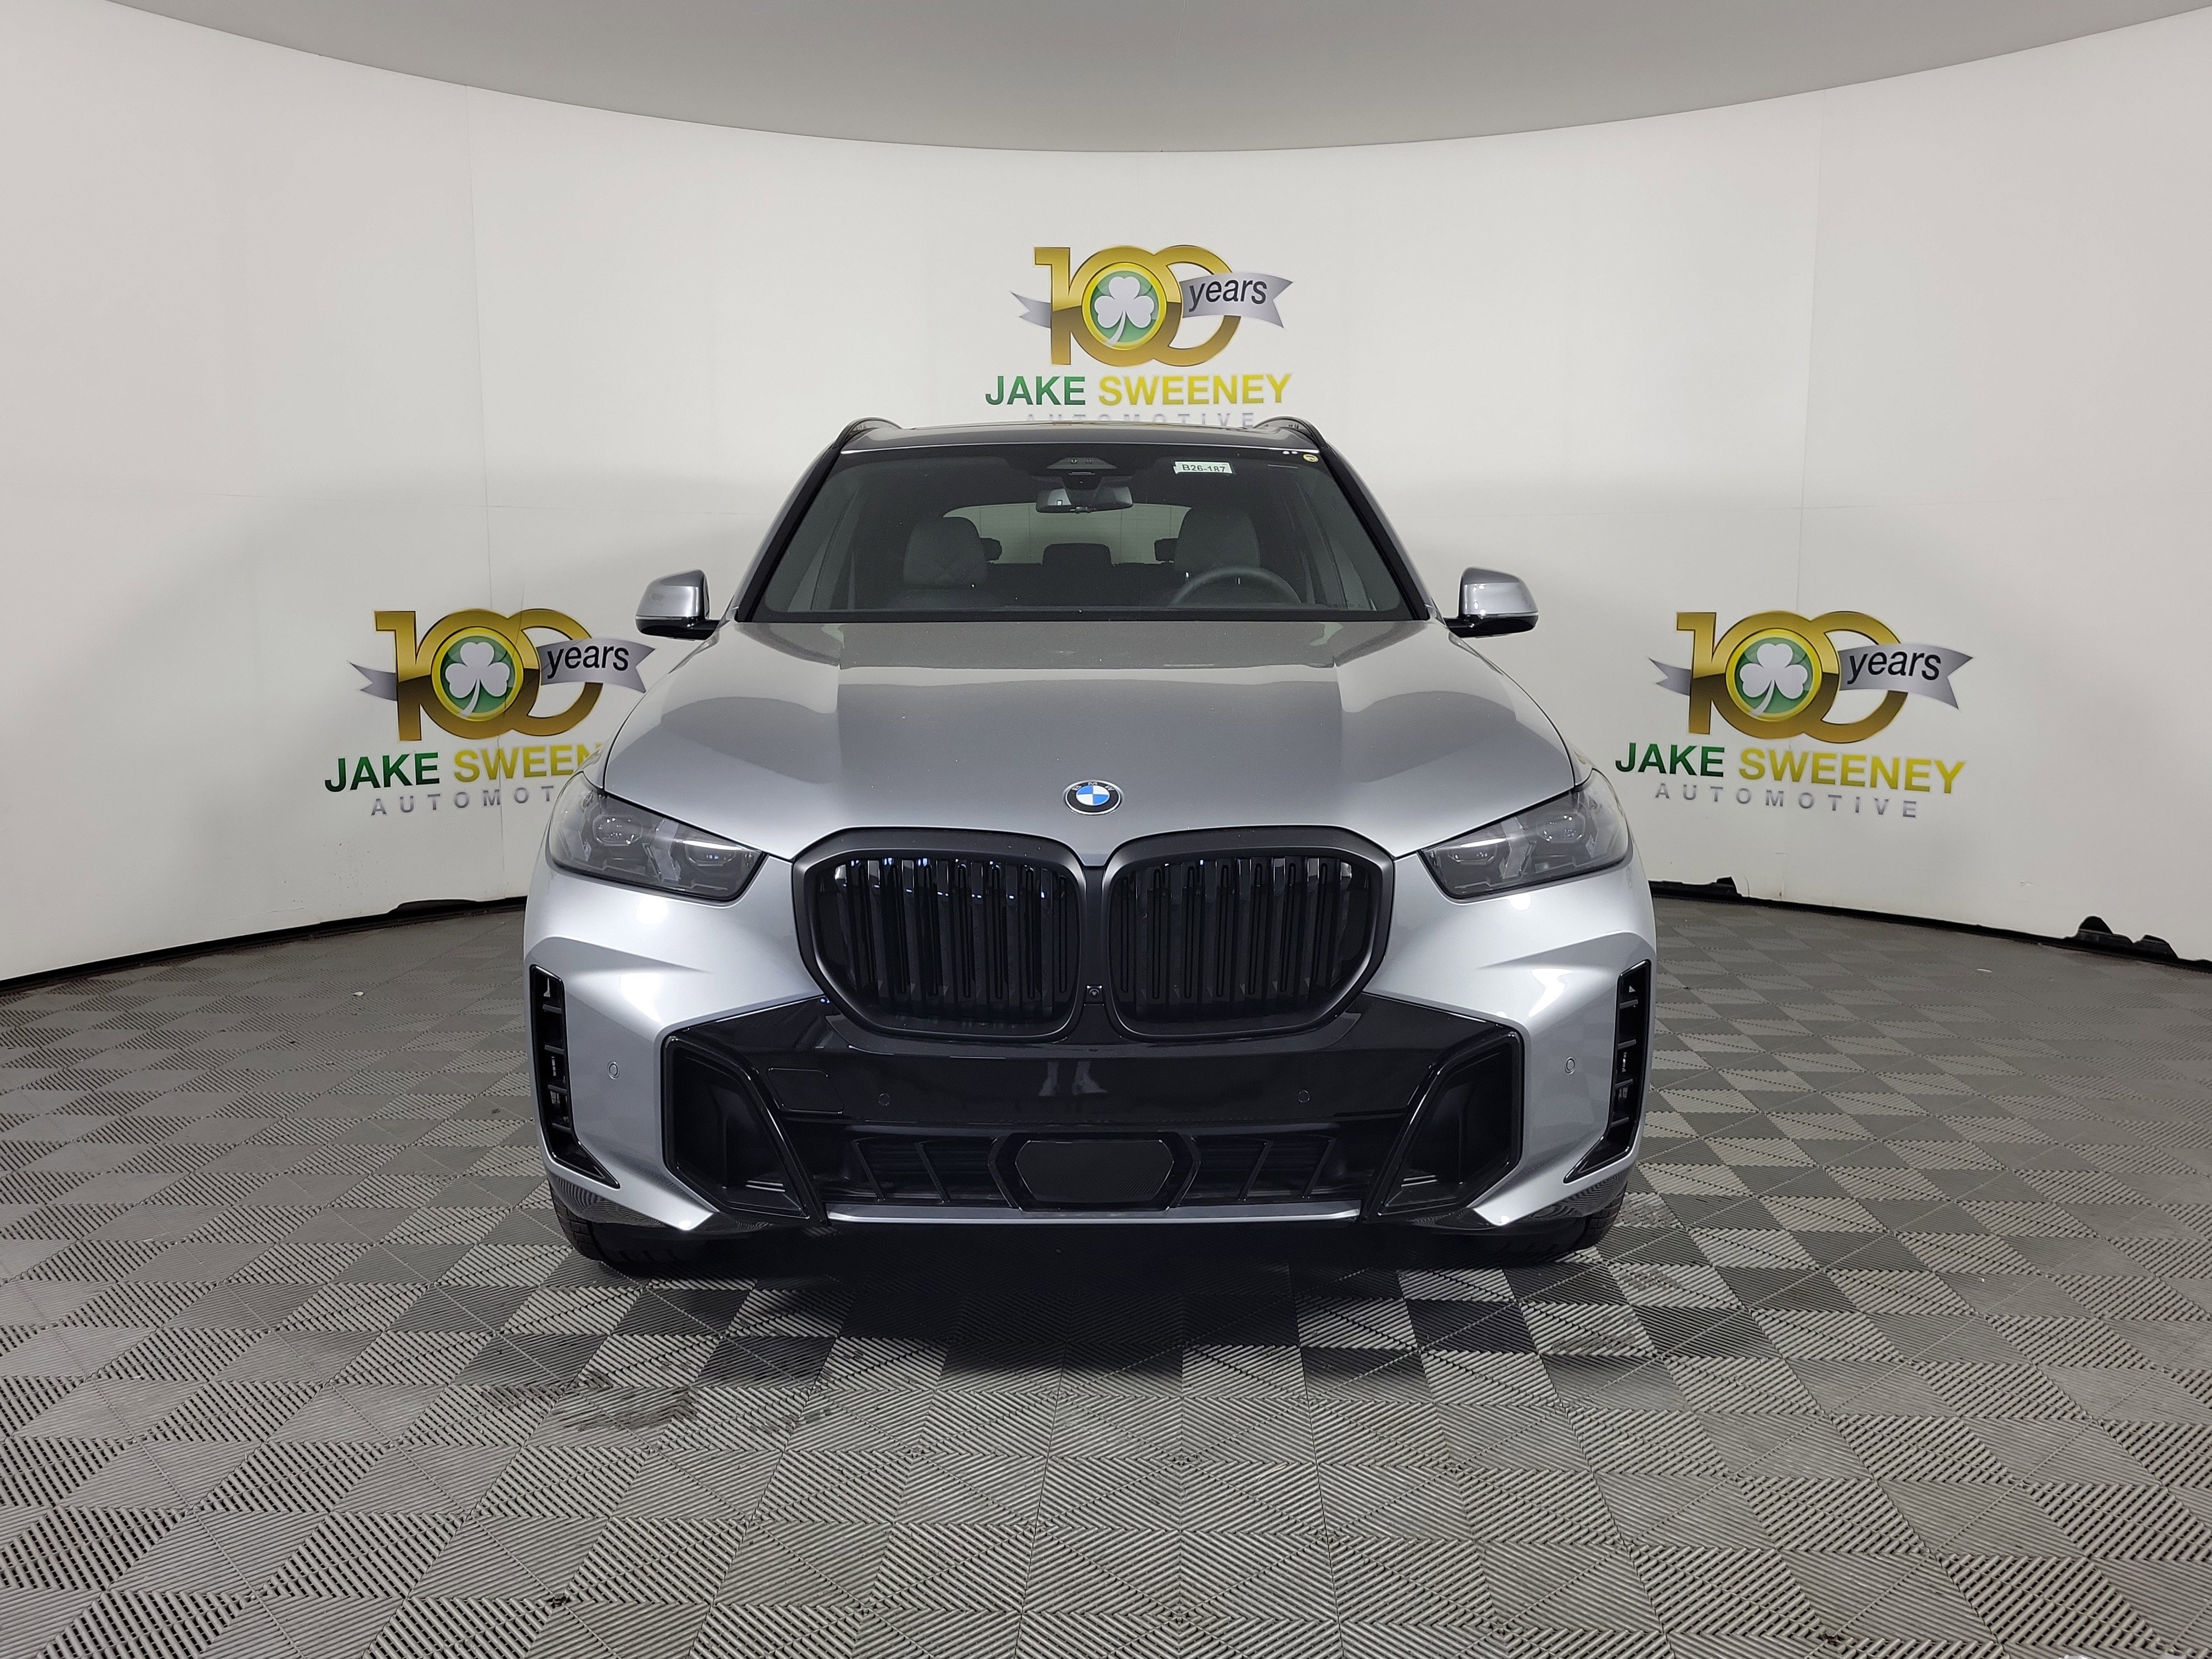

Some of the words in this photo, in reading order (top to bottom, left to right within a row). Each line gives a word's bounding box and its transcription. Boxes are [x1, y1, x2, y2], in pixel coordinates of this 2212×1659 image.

[1189, 279, 1267, 312] years
[985, 376, 1086, 405] JAKE
[1098, 374, 1292, 405] SWEENEY
[548, 645, 629, 679] years
[1847, 651, 1942, 685] years
[324, 752, 439, 792] JAKE
[454, 744, 601, 782] SWEE
[1615, 743, 1725, 777] JAKE
[1738, 747, 1966, 794] SWEENEY
[371, 785, 554, 816] AUTOMOT
[1071, 782, 1115, 791] BMW
[1655, 783, 1917, 818] AUTOMOTIVE
